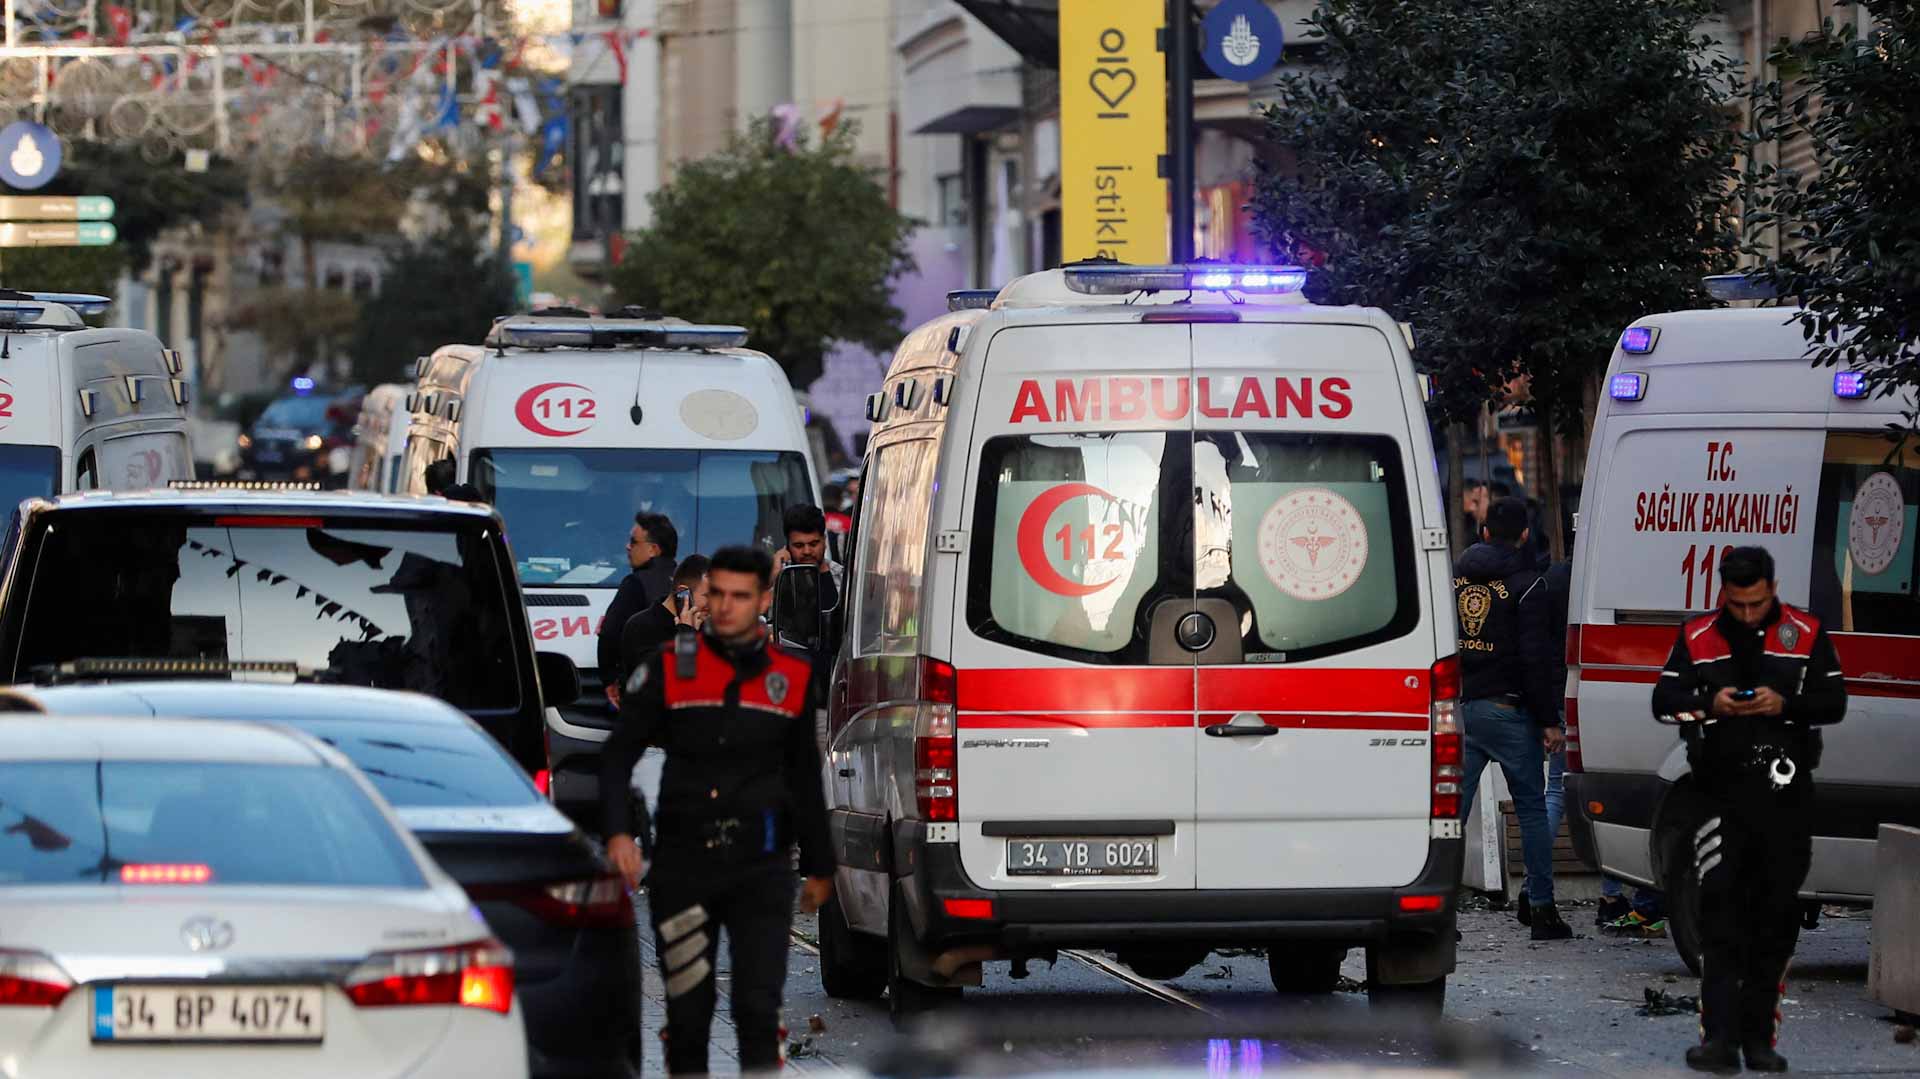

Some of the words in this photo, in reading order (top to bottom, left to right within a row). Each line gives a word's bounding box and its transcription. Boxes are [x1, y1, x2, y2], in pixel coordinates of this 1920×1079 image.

[536, 398, 597, 419] 112
[1008, 377, 1354, 423] AMBULANS
[1707, 441, 1736, 481] T.C.
[1634, 483, 1700, 532] SAĞLIK
[1702, 484, 1799, 535] BAKANLIĞI
[1055, 523, 1126, 561] 112
[1681, 544, 1734, 609] 11
[1401, 738, 1427, 747] CDI
[1022, 843, 1049, 867] 34
[1062, 843, 1089, 867] YB
[1105, 842, 1155, 867] 6021
[116, 995, 156, 1030] 34
[175, 995, 214, 1029] BP
[230, 995, 312, 1030] 4074
